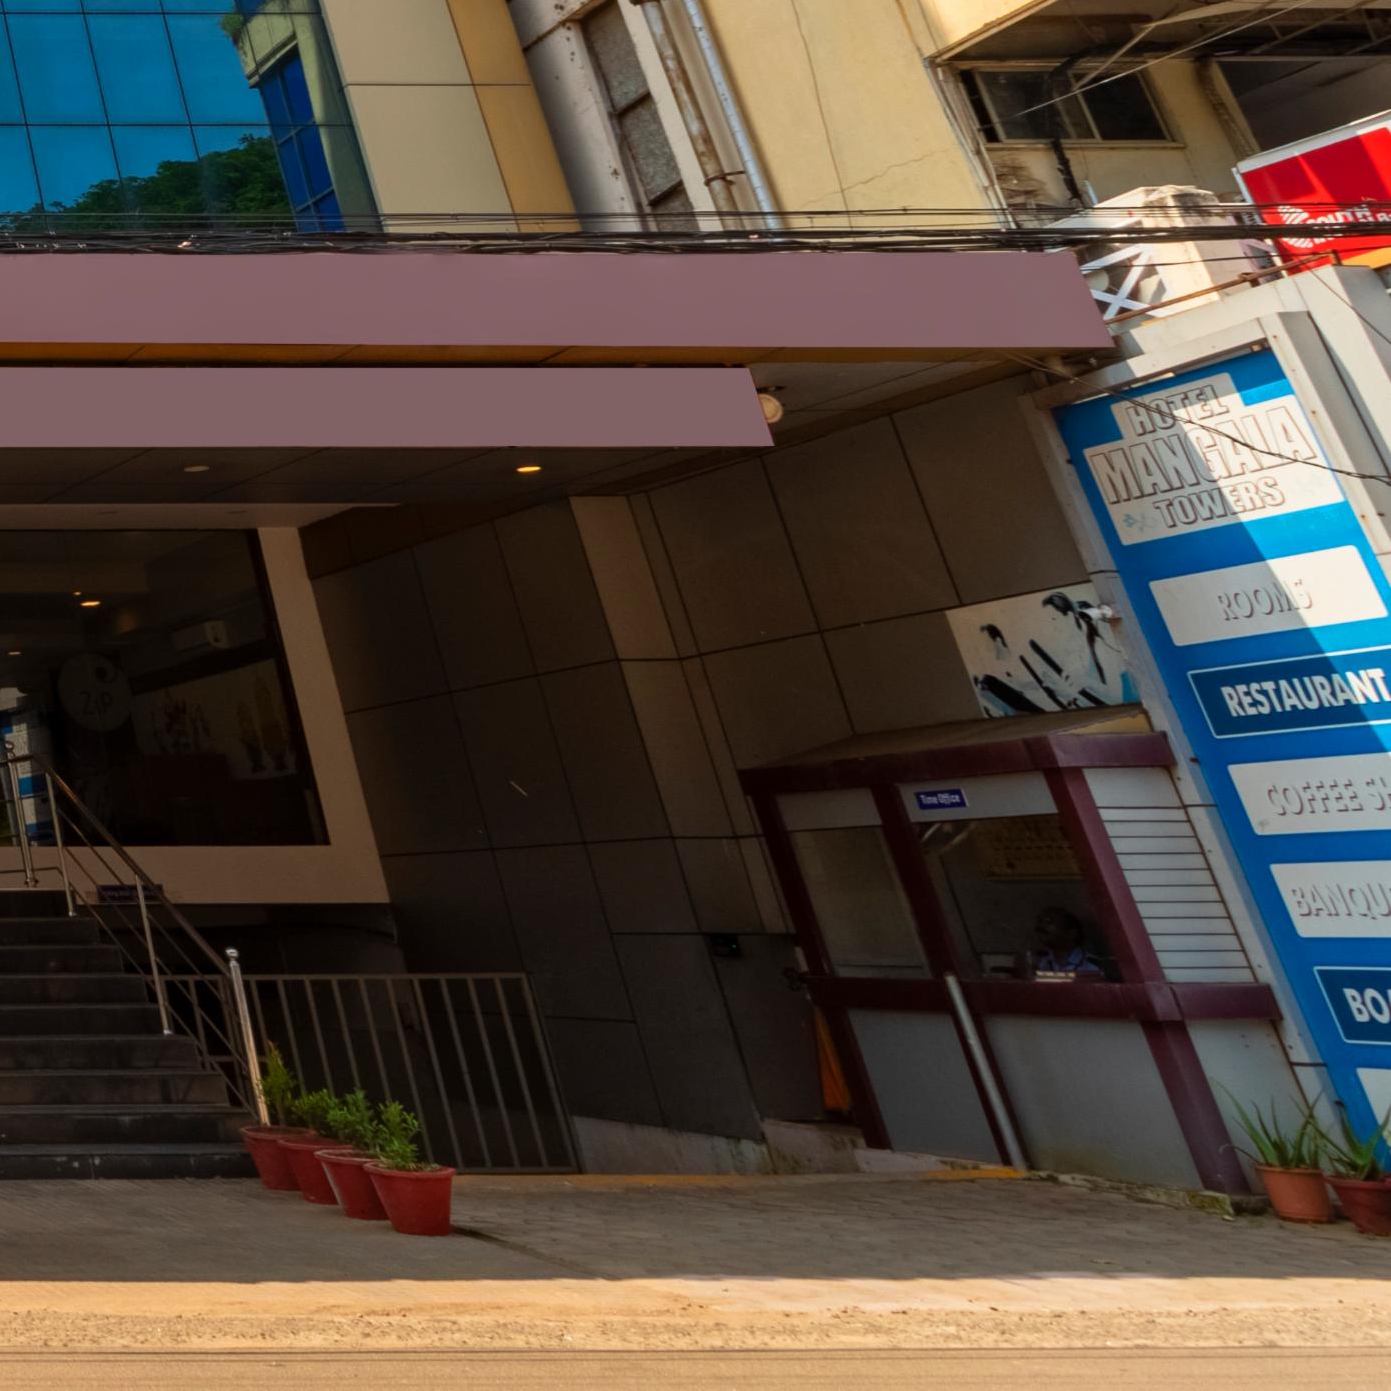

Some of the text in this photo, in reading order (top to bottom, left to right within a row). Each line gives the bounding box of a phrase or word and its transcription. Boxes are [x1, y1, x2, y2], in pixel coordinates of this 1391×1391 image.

[1124, 384, 1231, 436] HOTEL
[1090, 406, 1317, 505] MANGALA
[1153, 476, 1286, 528] TOWERS
[1218, 578, 1314, 622] ROOMS
[1221, 667, 1391, 717] RESTAURANT
[920, 792, 962, 806] Time Office
[1267, 778, 1364, 816] COFFEE
[1292, 883, 1391, 920] BANQU
[1343, 988, 1391, 1024] BO
